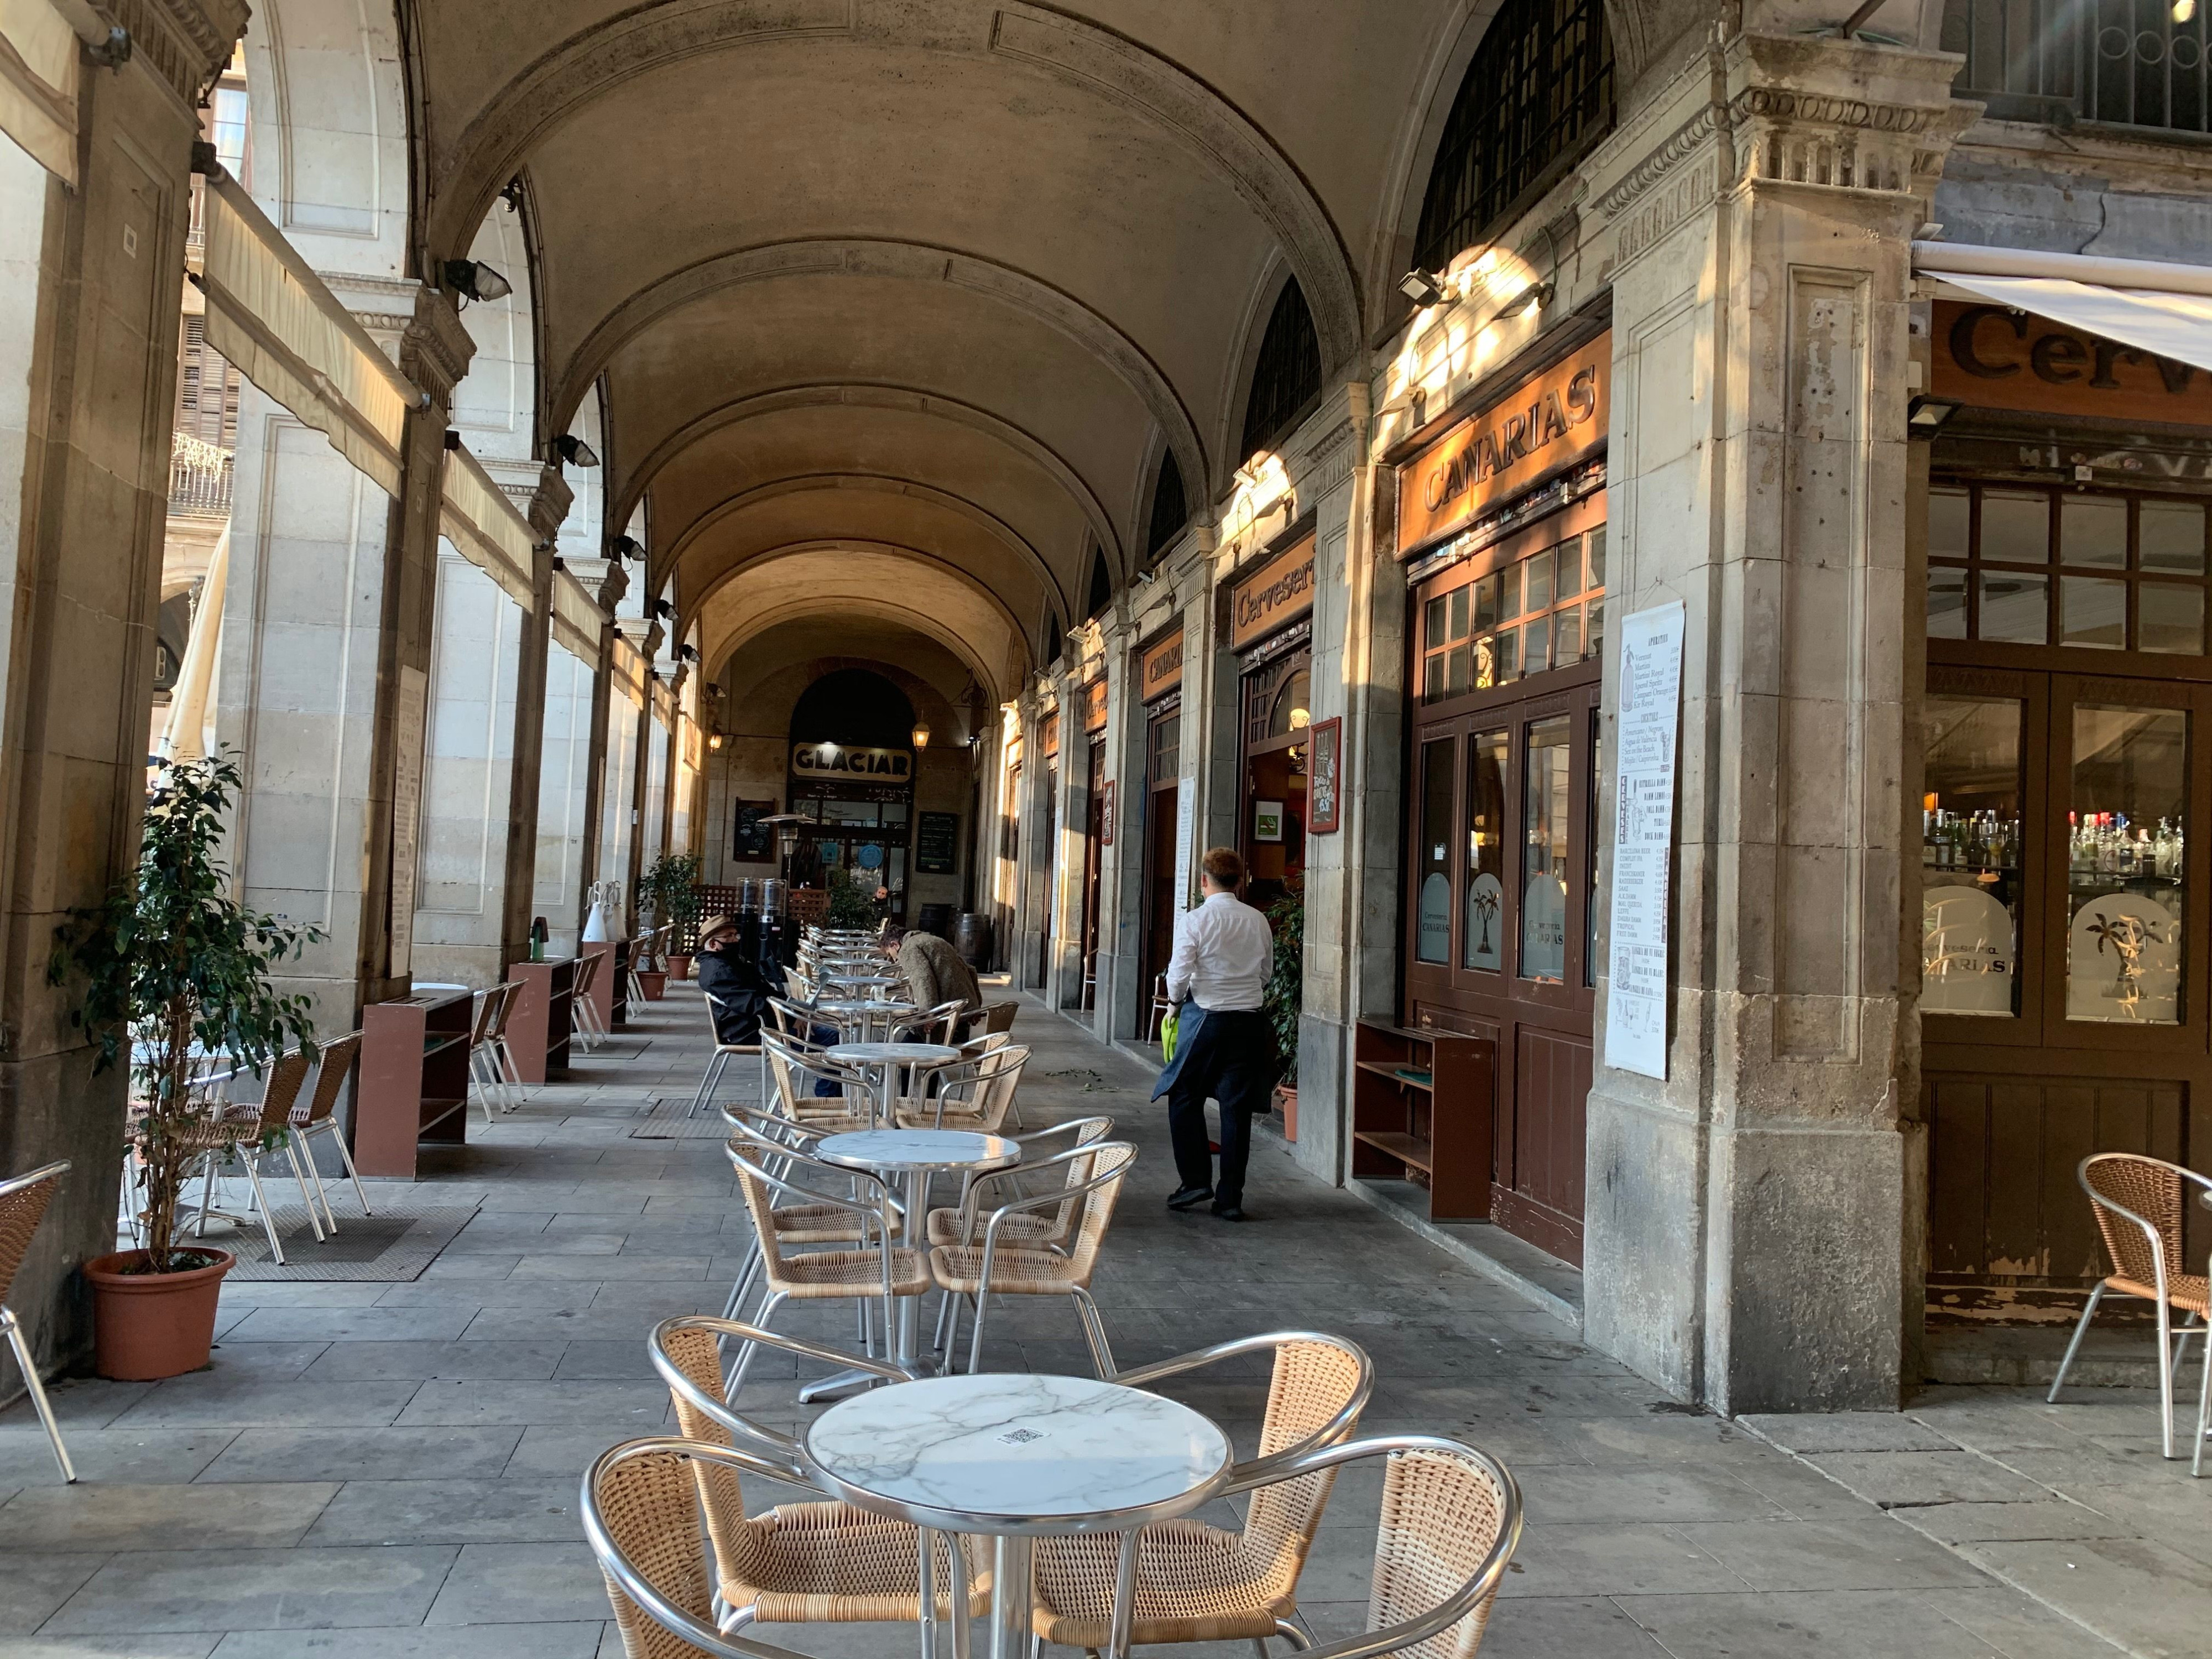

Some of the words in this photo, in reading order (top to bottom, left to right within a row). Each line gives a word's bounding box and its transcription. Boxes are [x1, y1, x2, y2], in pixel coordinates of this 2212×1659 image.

[1425, 364, 1595, 512] CANARIAS
[1635, 671, 1650, 680] Martini
[1651, 668, 1664, 677] Royal
[795, 748, 908, 776] GLACIAR
[1422, 923, 1449, 933] CANARIAS
